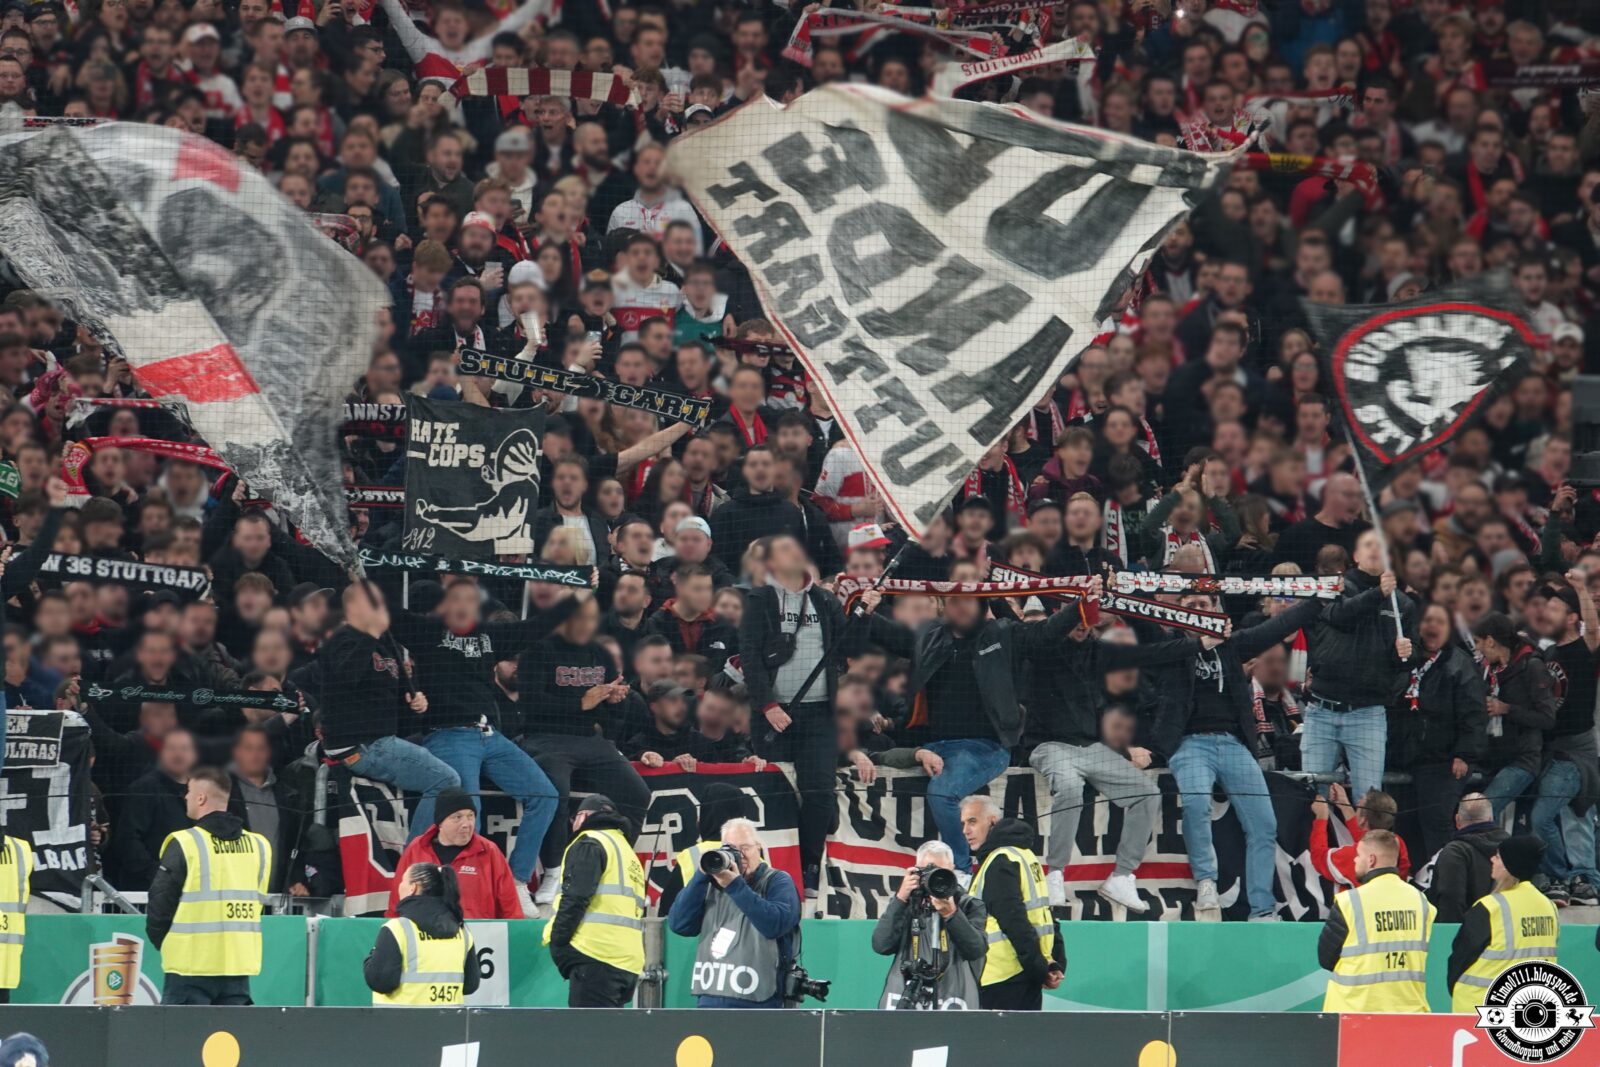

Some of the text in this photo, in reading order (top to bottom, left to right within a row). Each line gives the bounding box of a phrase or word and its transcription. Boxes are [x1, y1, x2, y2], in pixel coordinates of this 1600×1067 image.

[342, 403, 407, 421] ANNST
[411, 419, 459, 443] HATE
[428, 443, 486, 468] COPS
[66, 556, 92, 576] 36
[1115, 597, 1226, 634] STUTTGART
[226, 902, 255, 919] 3655
[1375, 909, 1417, 932] SECURITY
[1521, 915, 1554, 937] SECURITY
[691, 960, 759, 995] FOTO
[429, 981, 457, 998] 3457
